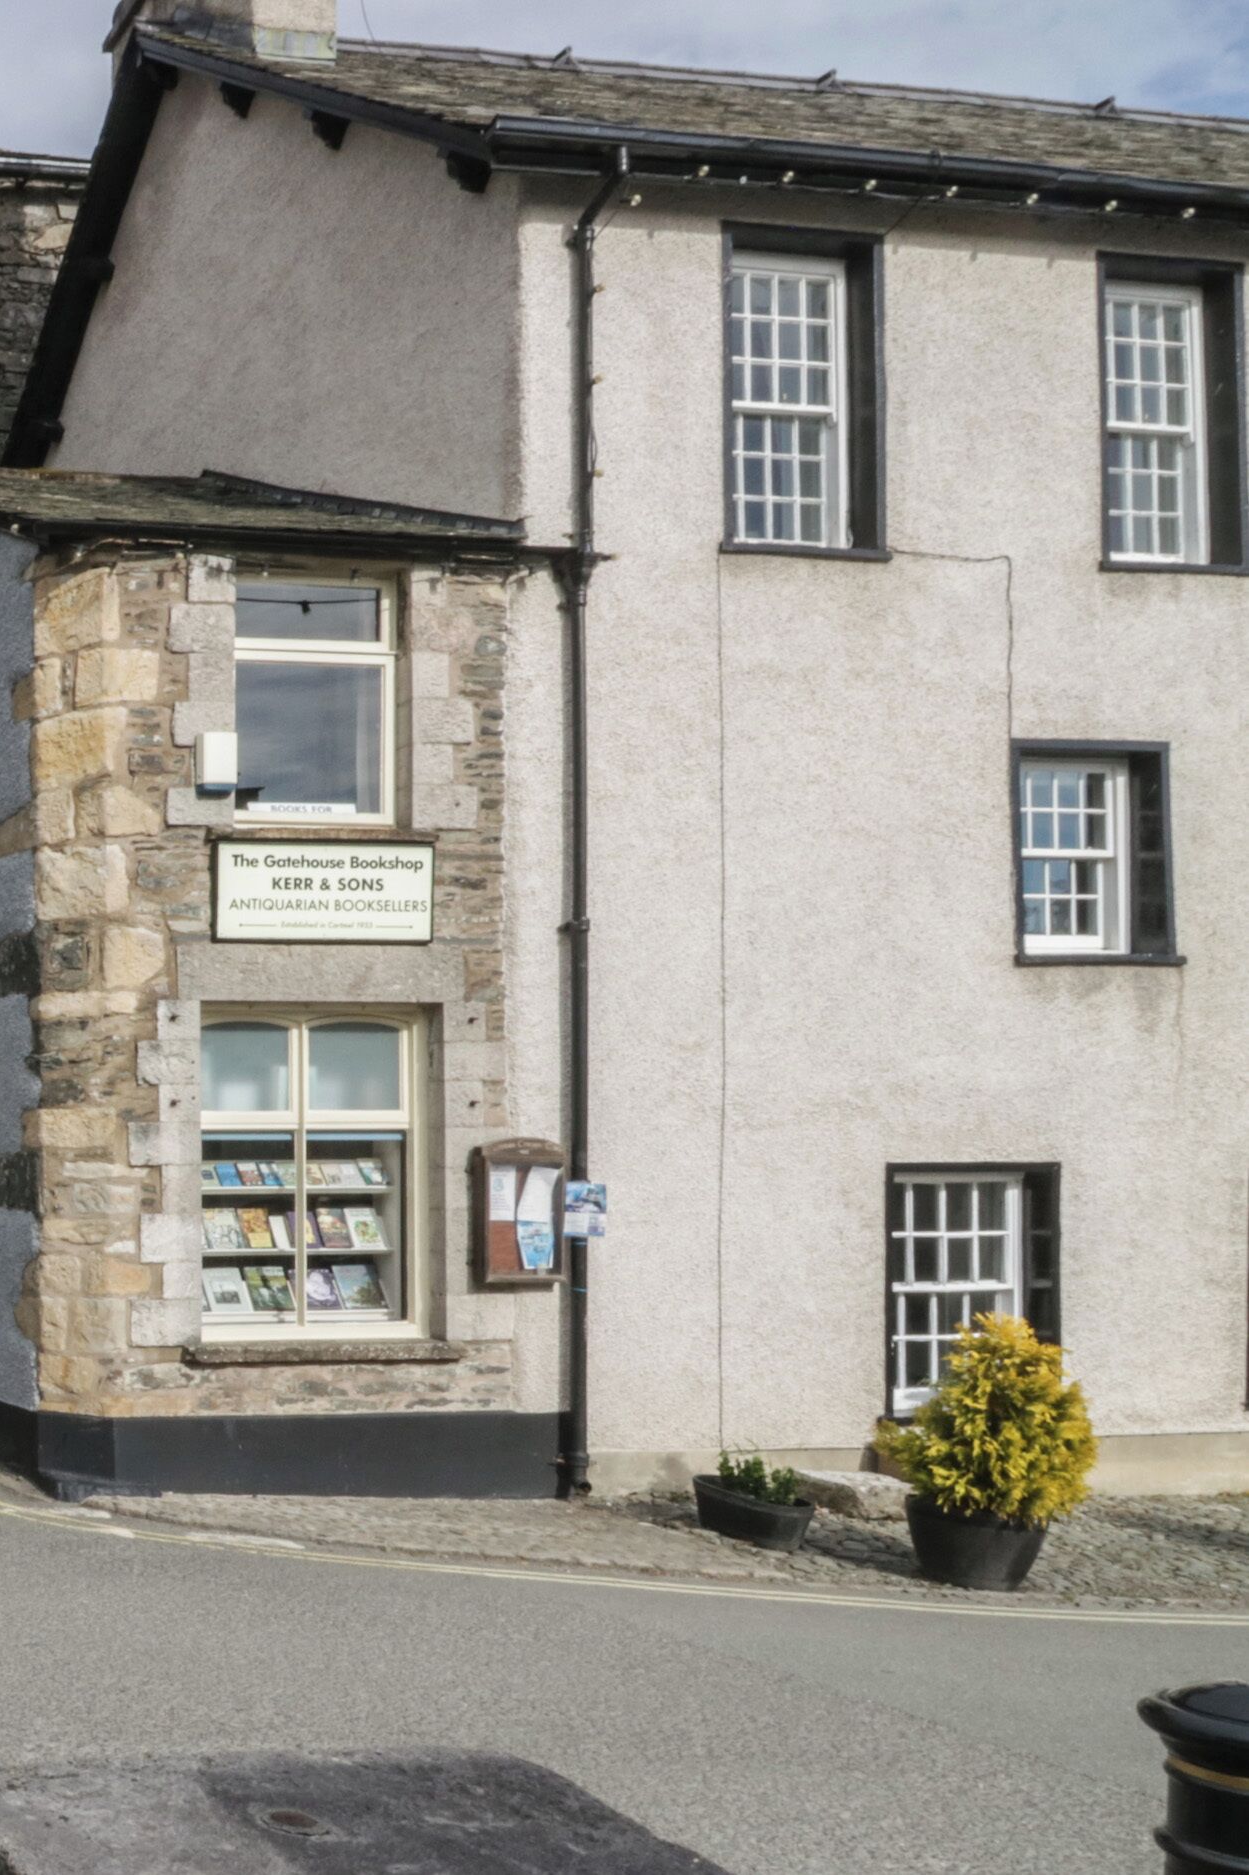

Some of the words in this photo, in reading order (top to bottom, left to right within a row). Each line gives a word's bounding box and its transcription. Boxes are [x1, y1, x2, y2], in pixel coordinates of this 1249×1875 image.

[270, 804, 307, 814] BOOKS
[311, 805, 333, 815] FOR
[232, 854, 259, 868] The
[264, 854, 345, 870] Gatehouse
[350, 855, 424, 873] Bookshop
[272, 877, 313, 891] KERR
[319, 878, 331, 891] &
[337, 878, 385, 892] SONS
[229, 898, 329, 912] ANTIQUARIAN
[334, 899, 428, 913] BOOKSELLERS
